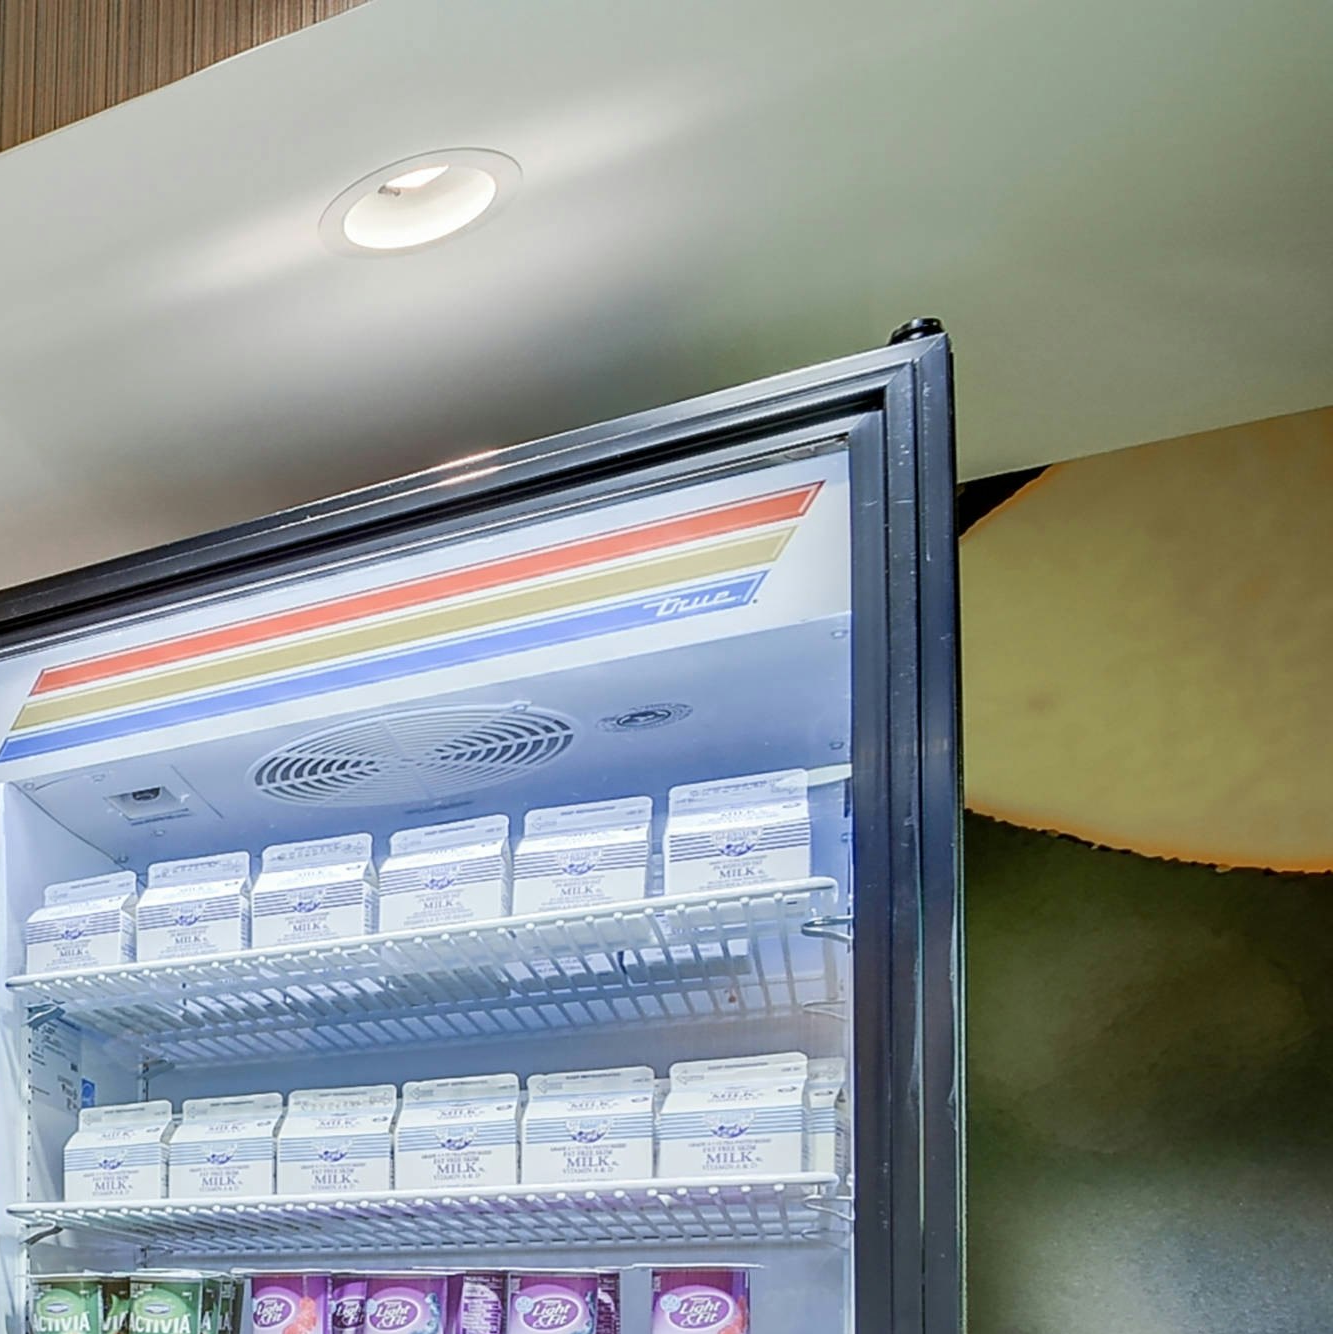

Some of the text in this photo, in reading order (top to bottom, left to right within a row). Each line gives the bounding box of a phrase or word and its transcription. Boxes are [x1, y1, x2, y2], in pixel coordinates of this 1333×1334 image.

[566, 1155, 610, 1168] MILK
[706, 1151, 753, 1164] MILK
[436, 1162, 477, 1175] MILK
[94, 1180, 128, 1192] MILK
[201, 1176, 238, 1188] MILK
[314, 1173, 351, 1185] MILK
[256, 1301, 285, 1316] Light
[376, 1302, 410, 1318] Light
[533, 1303, 569, 1318] Light
[680, 1299, 721, 1316] Light
[33, 1312, 90, 1332] ACTIVIA
[130, 1313, 191, 1334] ACTIVIA
